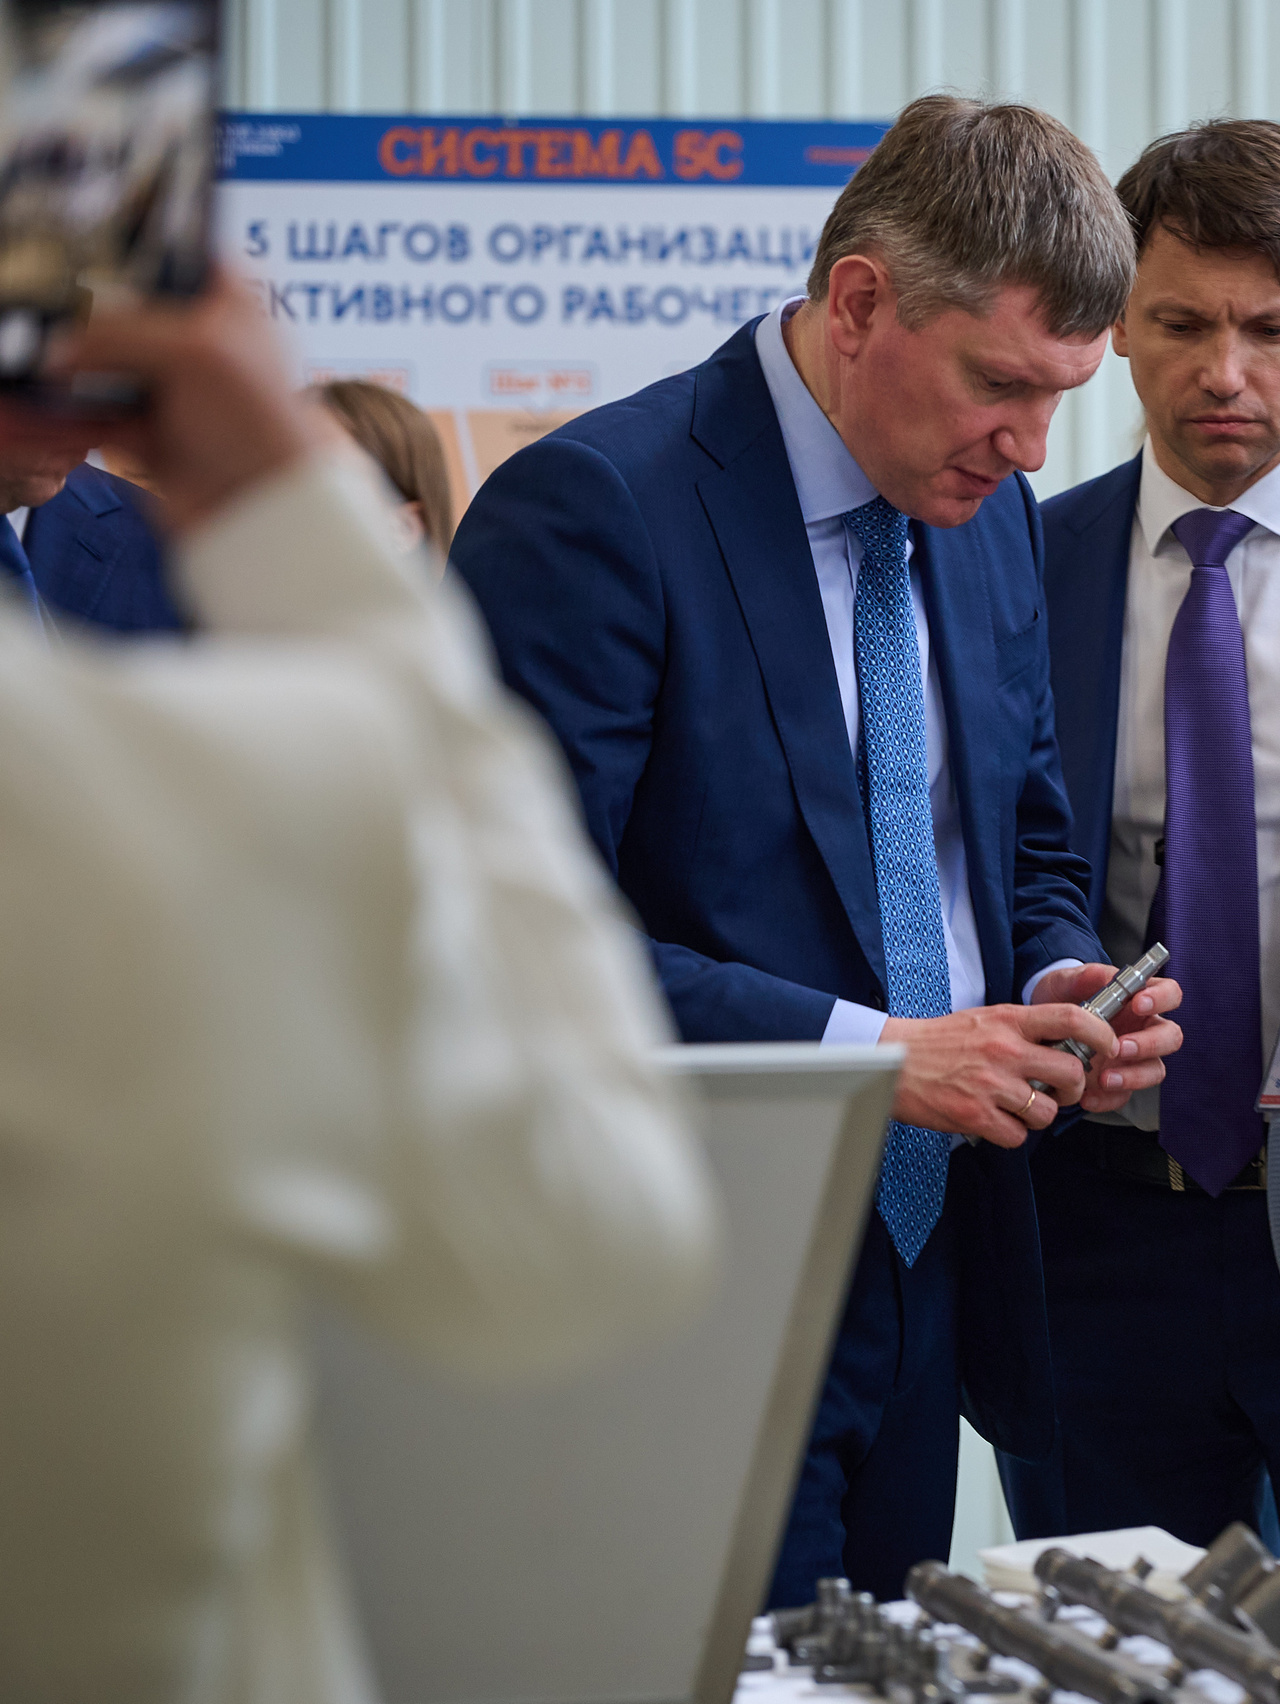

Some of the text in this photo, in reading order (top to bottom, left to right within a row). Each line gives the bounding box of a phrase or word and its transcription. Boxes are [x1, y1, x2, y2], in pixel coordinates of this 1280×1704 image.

[378, 125, 744, 180] СИСТЕМА 5С
[245, 219, 269, 259] 5
[286, 221, 471, 263] ШАГОВ
